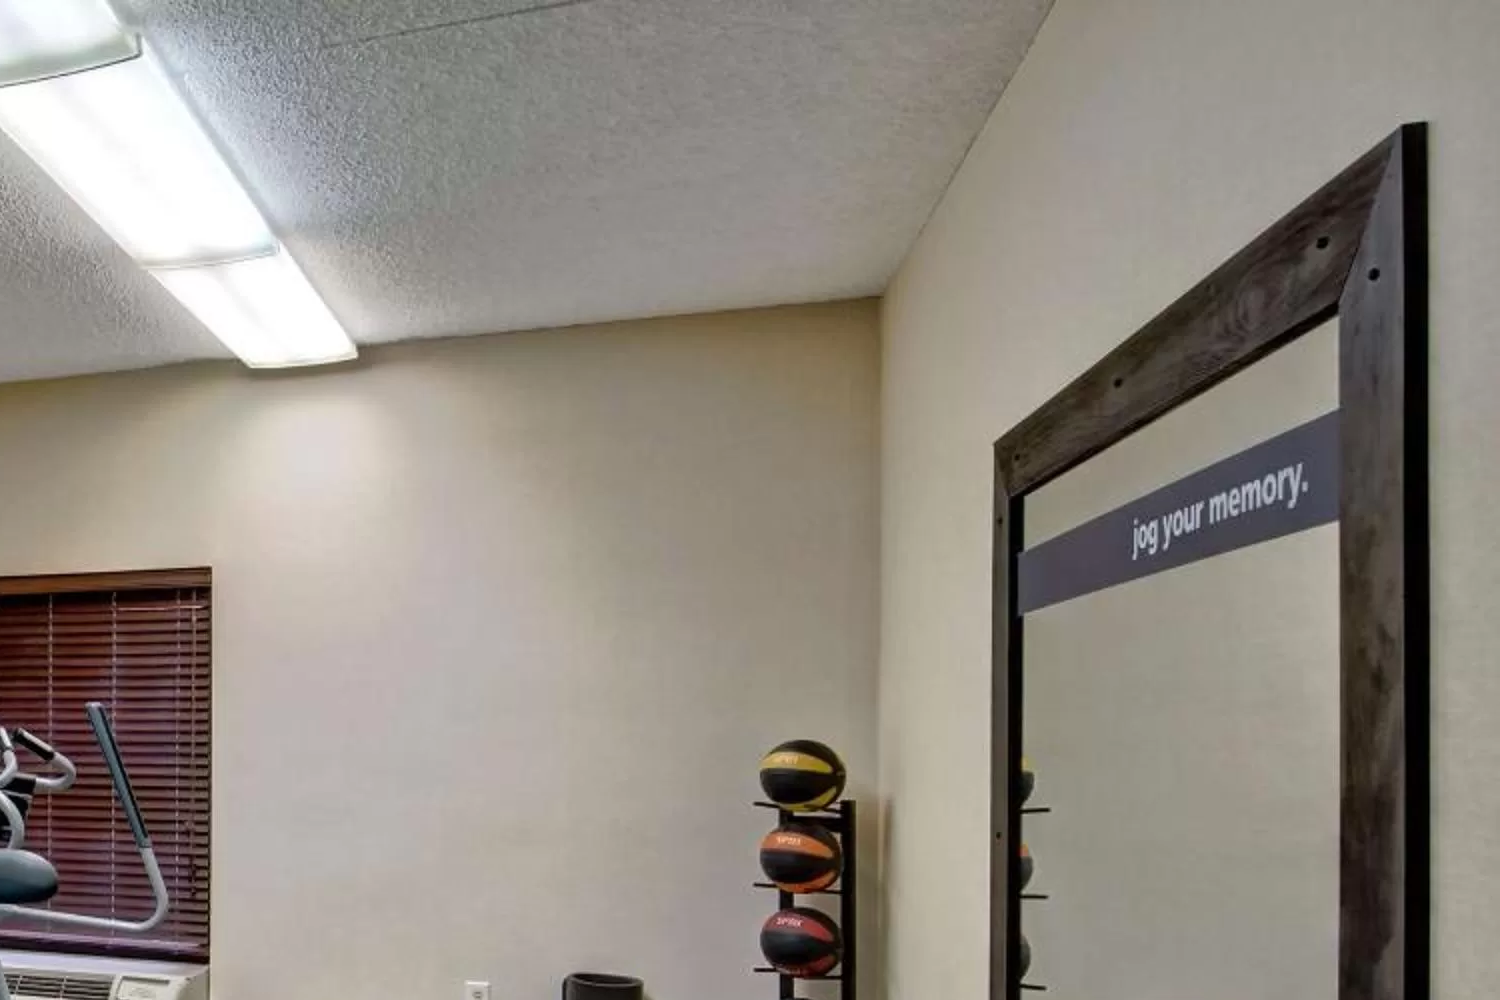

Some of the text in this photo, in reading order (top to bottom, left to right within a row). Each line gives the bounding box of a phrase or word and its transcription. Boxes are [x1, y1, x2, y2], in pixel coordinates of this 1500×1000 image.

[1132, 462, 1308, 560] jog your memory.
